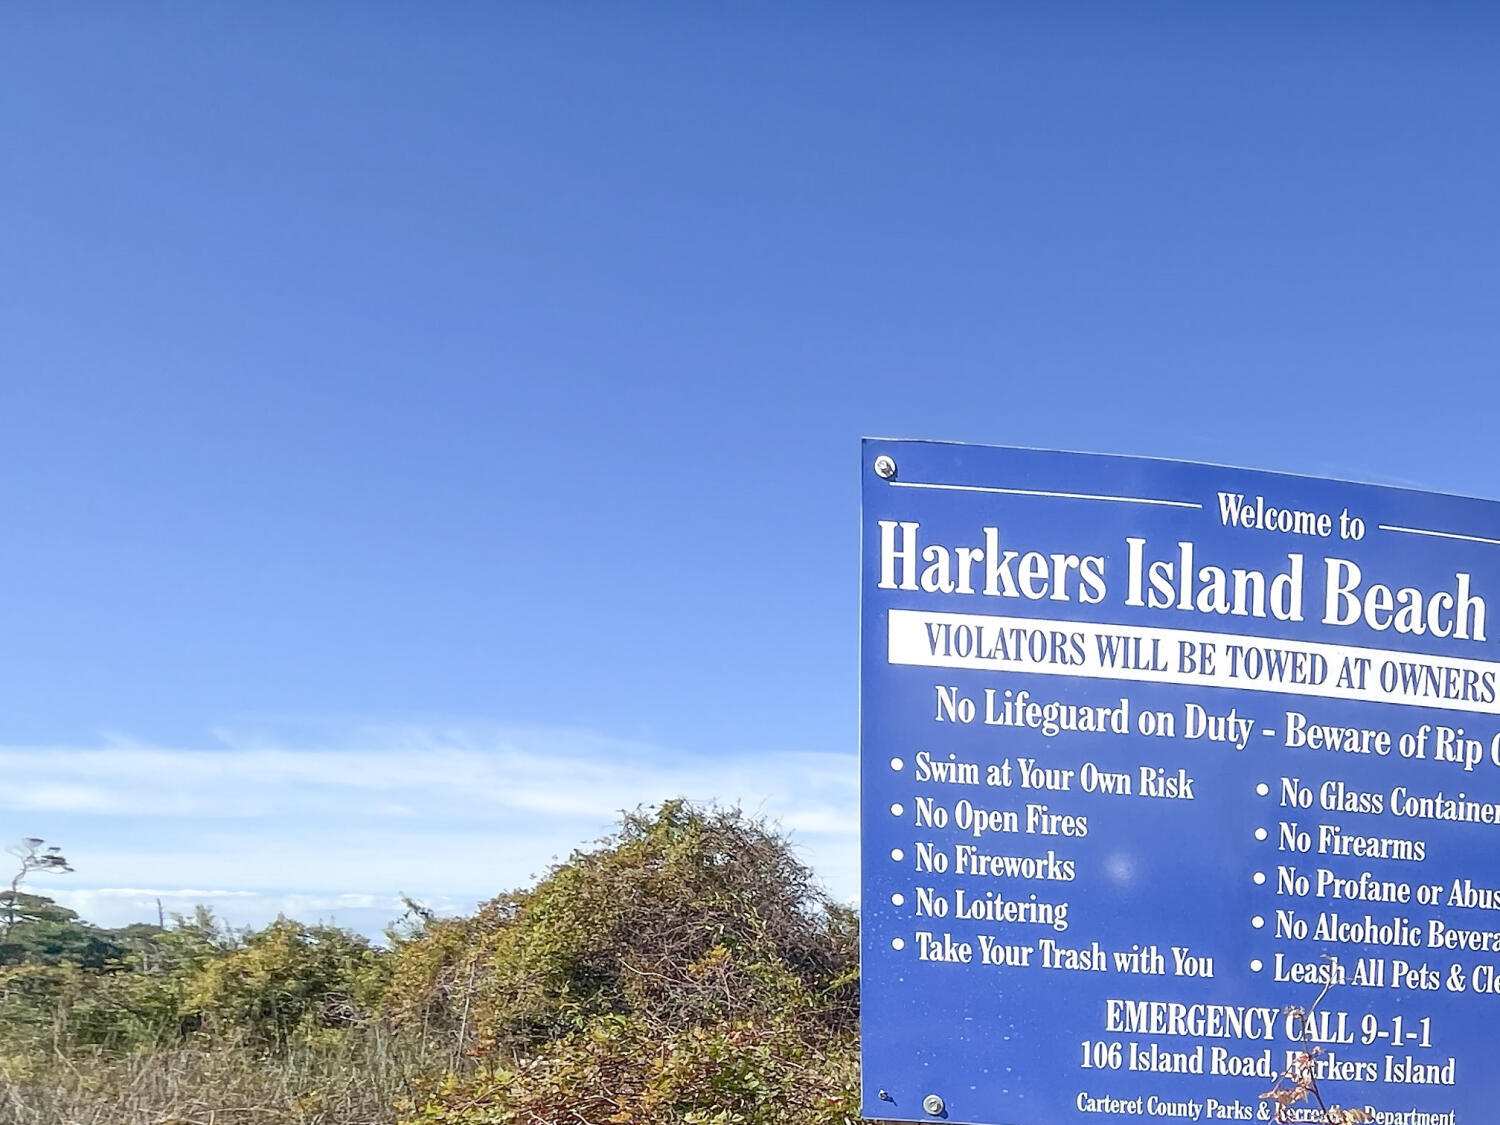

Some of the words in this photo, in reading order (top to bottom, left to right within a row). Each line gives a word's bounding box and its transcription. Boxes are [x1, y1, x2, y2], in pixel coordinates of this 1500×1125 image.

[1217, 492, 1332, 537] Welcome
[1339, 508, 1365, 541] to
[877, 520, 1107, 604] Harkers
[1124, 537, 1304, 622] Island
[1321, 557, 1487, 642] Beach
[924, 622, 1086, 666] VIOLATORS
[1095, 634, 1168, 672] WILL
[1178, 640, 1216, 676] BE
[1225, 644, 1328, 685] TOWED
[1335, 656, 1372, 690] AT
[1379, 660, 1496, 704] OWNERS
[935, 685, 976, 724] No
[983, 688, 1130, 737] Lifeguard
[1138, 710, 1175, 737] on
[1183, 703, 1255, 751] Duty
[1262, 729, 1276, 737] -
[1284, 711, 1391, 756] Beware
[1399, 724, 1432, 759] of
[1434, 726, 1483, 772] Rip
[915, 751, 980, 785] Swim
[986, 758, 1013, 787] at
[1016, 757, 1075, 791] Your
[1080, 762, 1132, 795] Own
[1138, 766, 1194, 800] Risk
[1279, 777, 1313, 809] No
[1319, 780, 1384, 815] Glass
[914, 796, 949, 829] No
[954, 799, 1019, 838] Open
[1025, 804, 1088, 838] Fires
[914, 842, 949, 874] No
[954, 844, 1076, 881] Fireworks
[1278, 821, 1312, 853] No
[1317, 824, 1426, 861] Firearms
[1276, 865, 1310, 897] No
[1316, 868, 1411, 903] Profane
[1416, 884, 1444, 905] or
[915, 887, 949, 918] No
[955, 889, 1069, 932] Loitering
[1275, 909, 1308, 940] No
[1312, 912, 1422, 947] Alcoholic
[915, 931, 973, 964] Take
[977, 935, 1034, 967] Your
[1038, 938, 1107, 972] Trash
[1112, 944, 1165, 975] with
[1170, 946, 1214, 978] You
[1273, 952, 1346, 987] Leash
[1350, 958, 1384, 987] All
[1391, 960, 1440, 991] Pets
[1446, 963, 1466, 992] &
[1105, 999, 1280, 1040] EMERGENCY
[1285, 1009, 1355, 1044] CALL
[1361, 1014, 1432, 1048] 9-1-1
[1080, 1040, 1123, 1070] 106
[1128, 1042, 1204, 1074] Island
[1209, 1046, 1278, 1083] Road,
[1383, 1055, 1455, 1085] Island
[1076, 1092, 1144, 1115] Carteret
[1146, 1095, 1203, 1122] County
[1206, 1098, 1253, 1120] Parks
[1256, 1100, 1272, 1122] &
